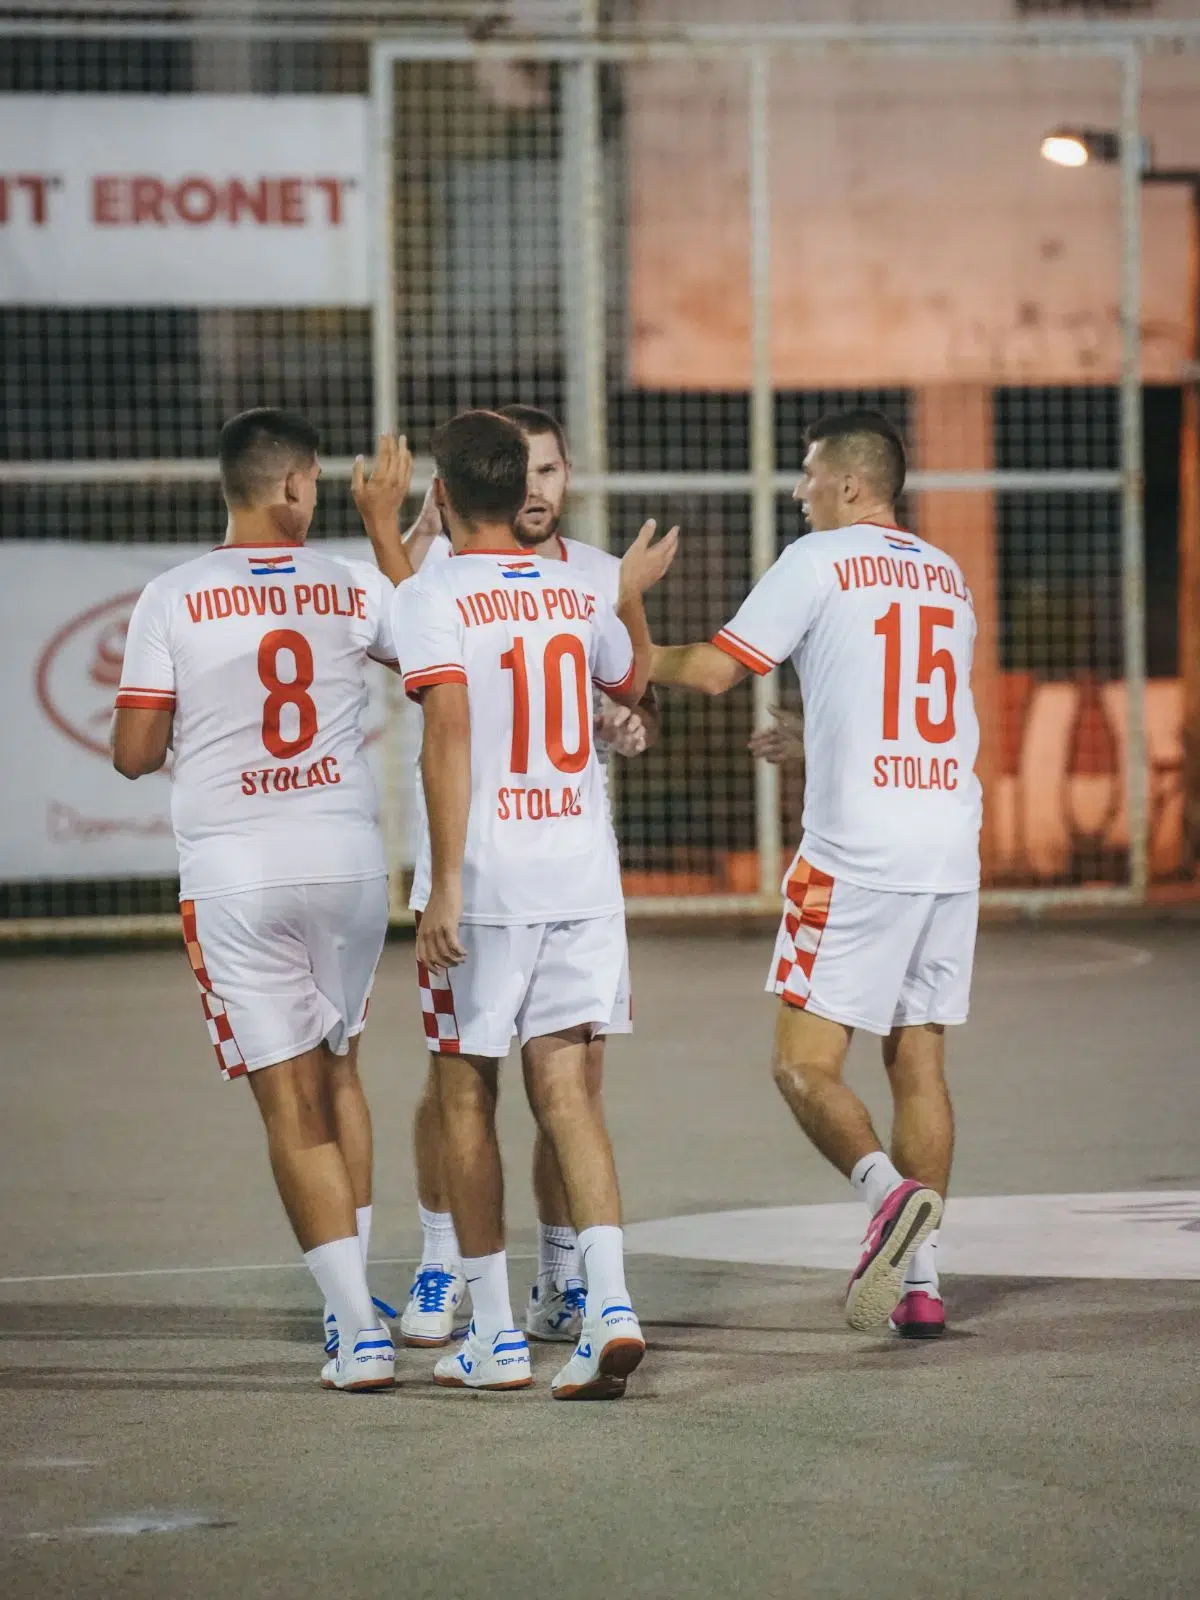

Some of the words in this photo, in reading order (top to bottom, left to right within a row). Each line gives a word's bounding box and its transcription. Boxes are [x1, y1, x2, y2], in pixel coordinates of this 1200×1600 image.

[92, 175, 352, 226] ERONET
[834, 555, 919, 591] VIDOVO
[923, 563, 967, 601] POL
[184, 585, 287, 623] VIDOVO
[293, 583, 367, 620] POLJE
[257, 628, 318, 759] 8
[874, 601, 957, 743] 15
[500, 633, 590, 774] 10
[241, 756, 341, 795] STOLAC
[874, 755, 958, 790] STOLAC
